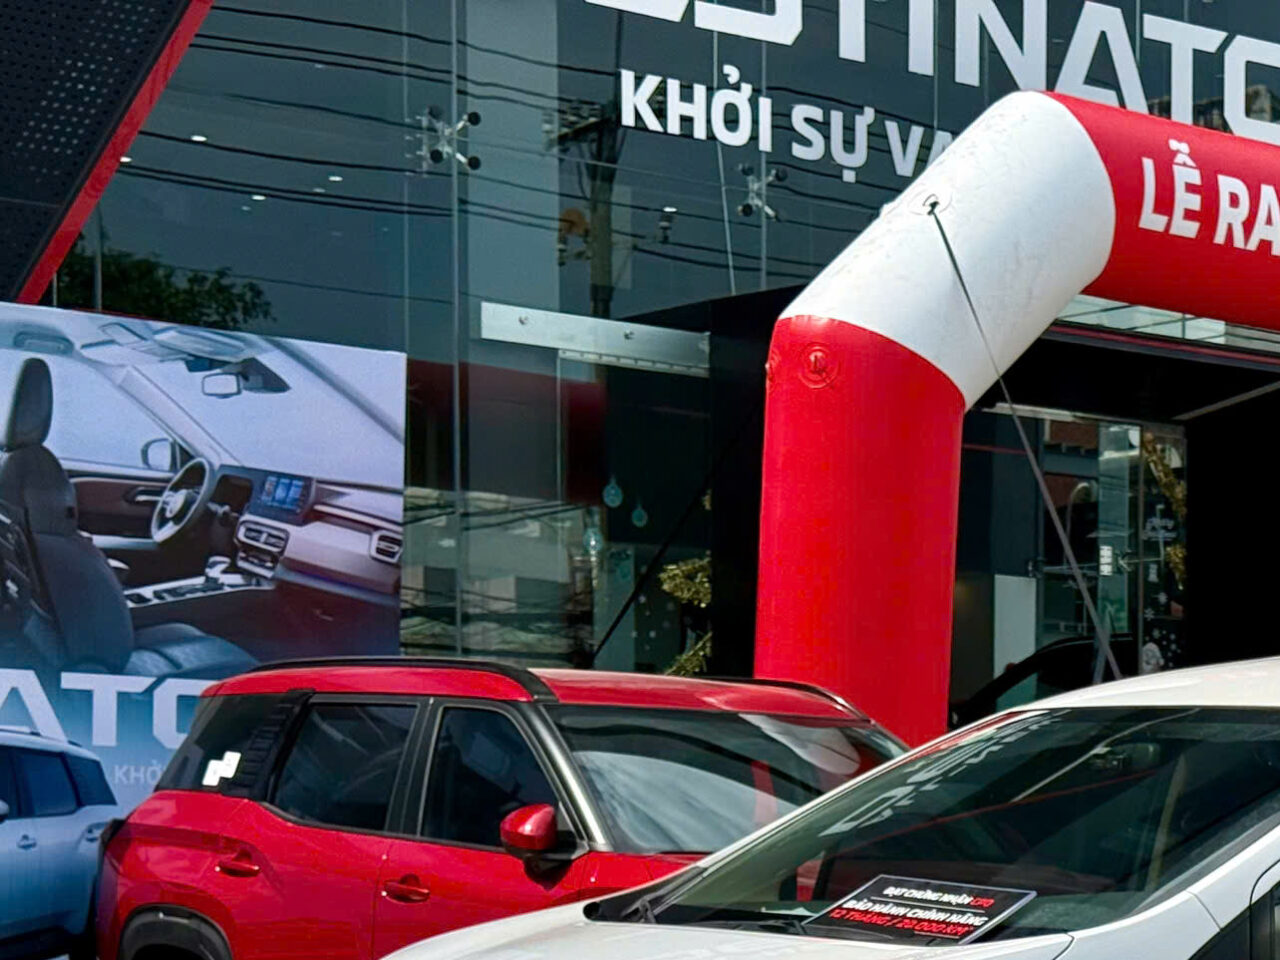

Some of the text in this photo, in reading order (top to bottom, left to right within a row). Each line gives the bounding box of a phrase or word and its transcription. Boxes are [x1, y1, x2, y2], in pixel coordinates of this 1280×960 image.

[620, 64, 773, 152] KHỞI
[791, 104, 875, 183] SỰ
[1138, 138, 1202, 239] LỄ
[841, 898, 873, 911] BẢO
[868, 903, 911, 916] HÀNH
[945, 913, 989, 926] HÃNG
